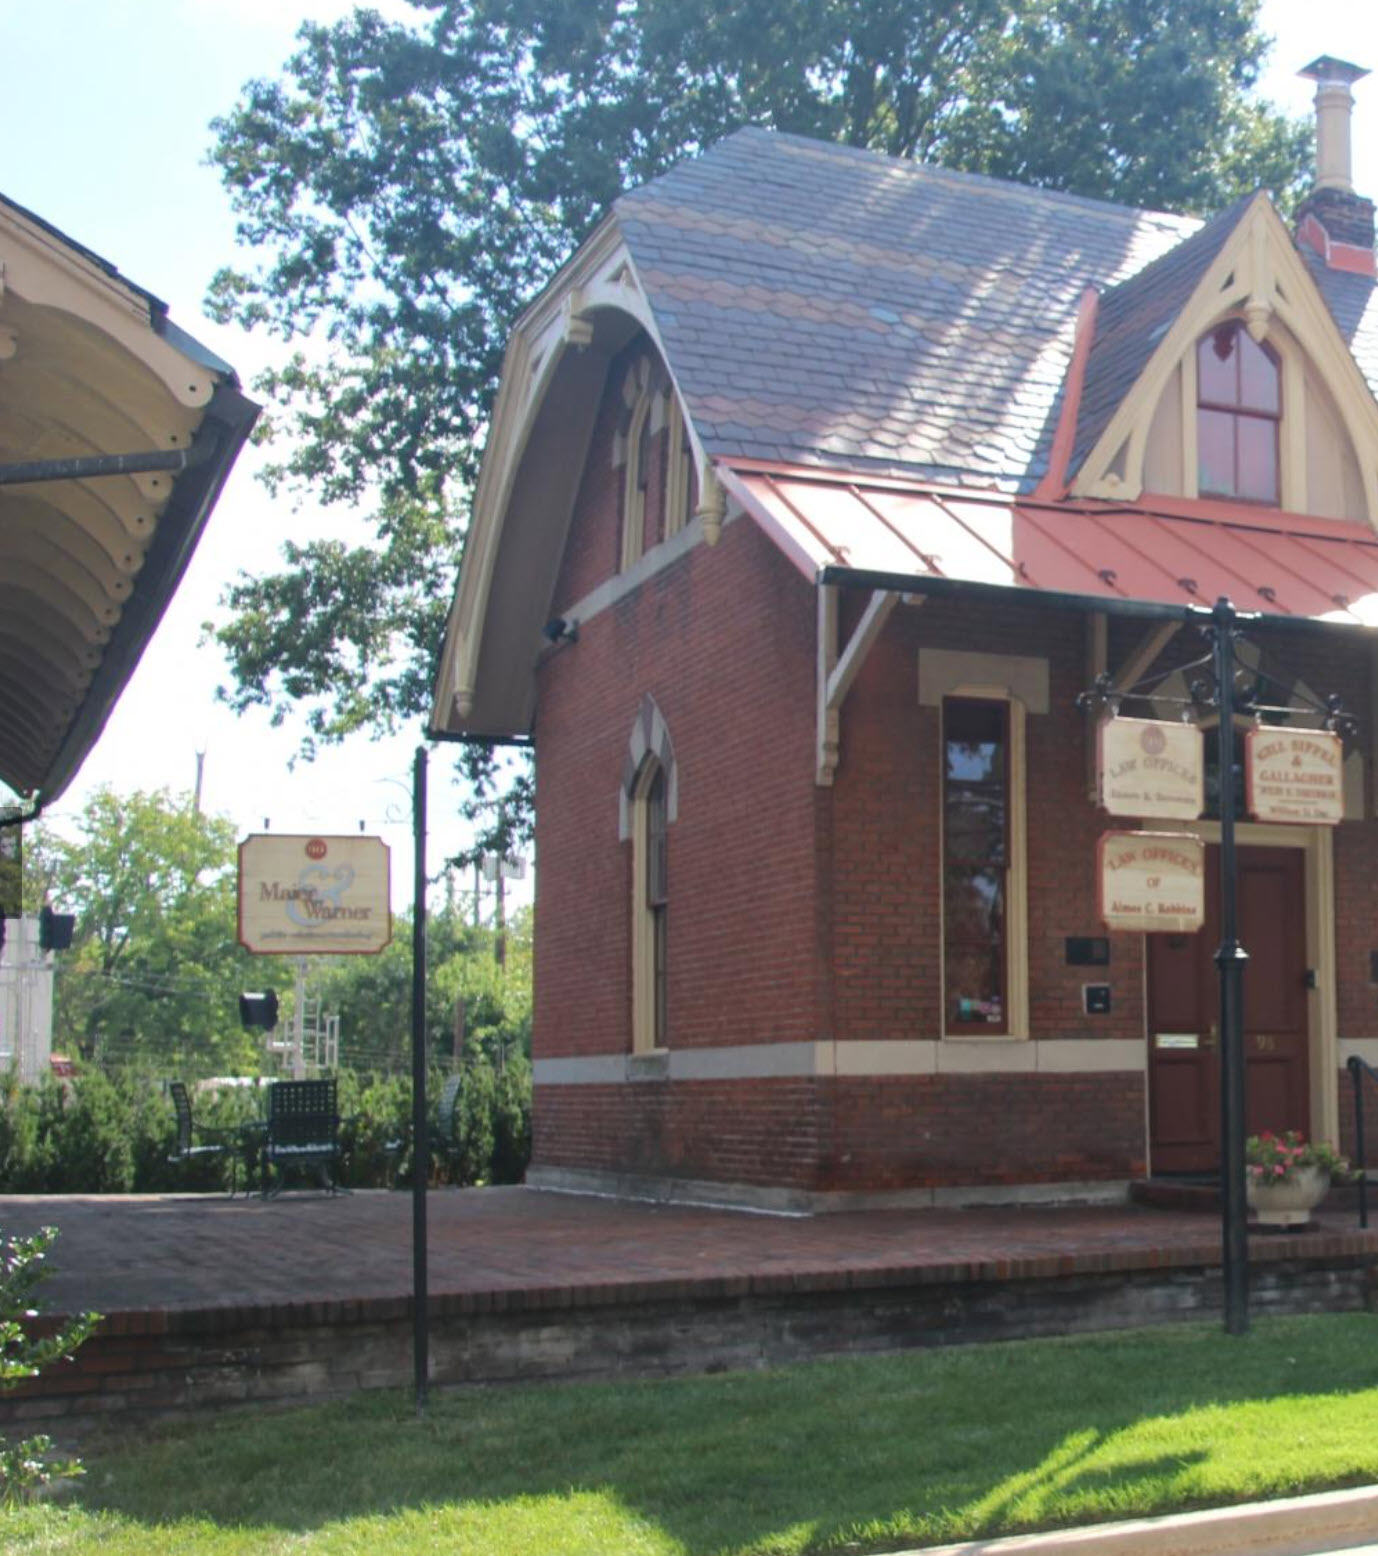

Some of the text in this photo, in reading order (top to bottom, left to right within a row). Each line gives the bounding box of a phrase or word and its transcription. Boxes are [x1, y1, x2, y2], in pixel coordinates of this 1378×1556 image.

[1109, 756, 1197, 784] LAW OFFICES
[1259, 769, 1333, 785] GALLAGHER
[1109, 848, 1199, 876] LAW OFFICES
[260, 881, 317, 902] Maier
[1146, 877, 1161, 888] OF
[303, 900, 372, 920] Warner
